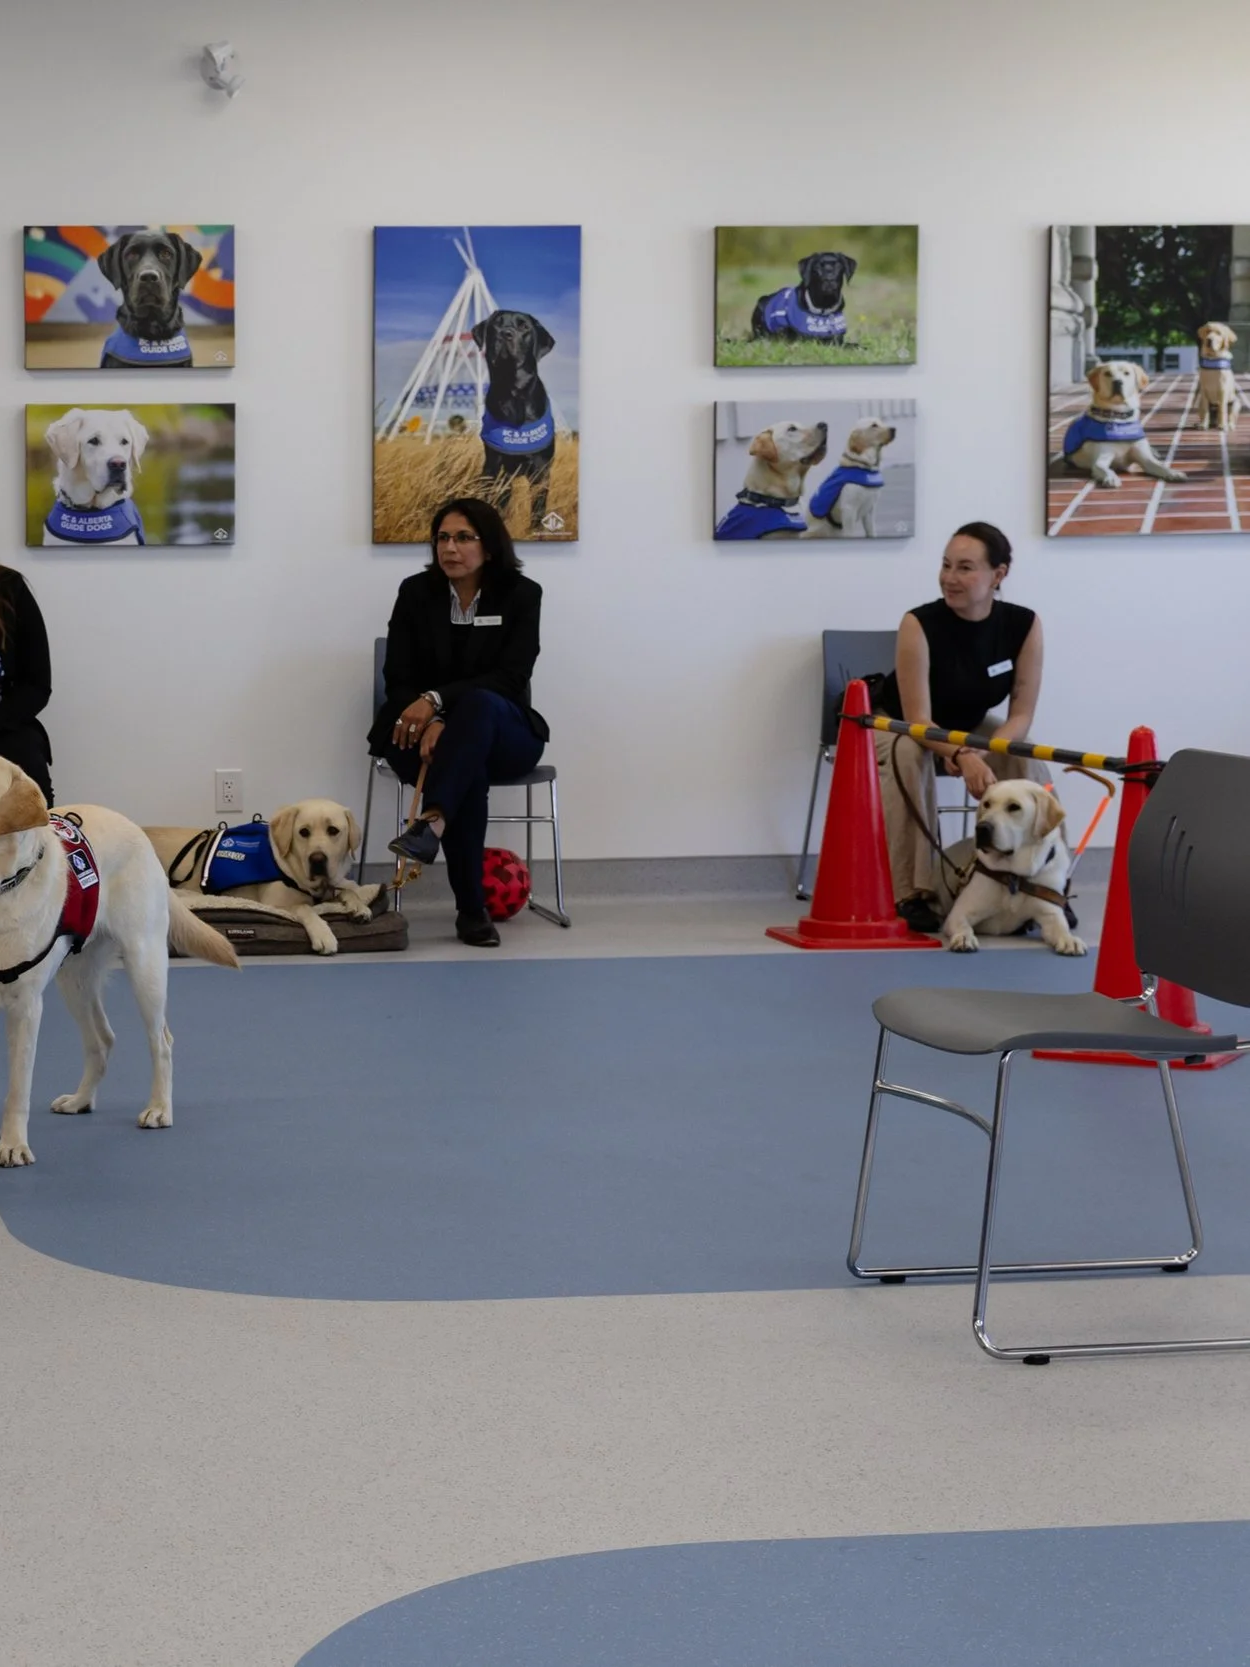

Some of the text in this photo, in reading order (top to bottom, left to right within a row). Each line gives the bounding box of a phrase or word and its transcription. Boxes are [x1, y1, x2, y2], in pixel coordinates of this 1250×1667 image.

[77, 514, 113, 524] ALBERTA
[60, 521, 112, 532] GUIDE DOGS
